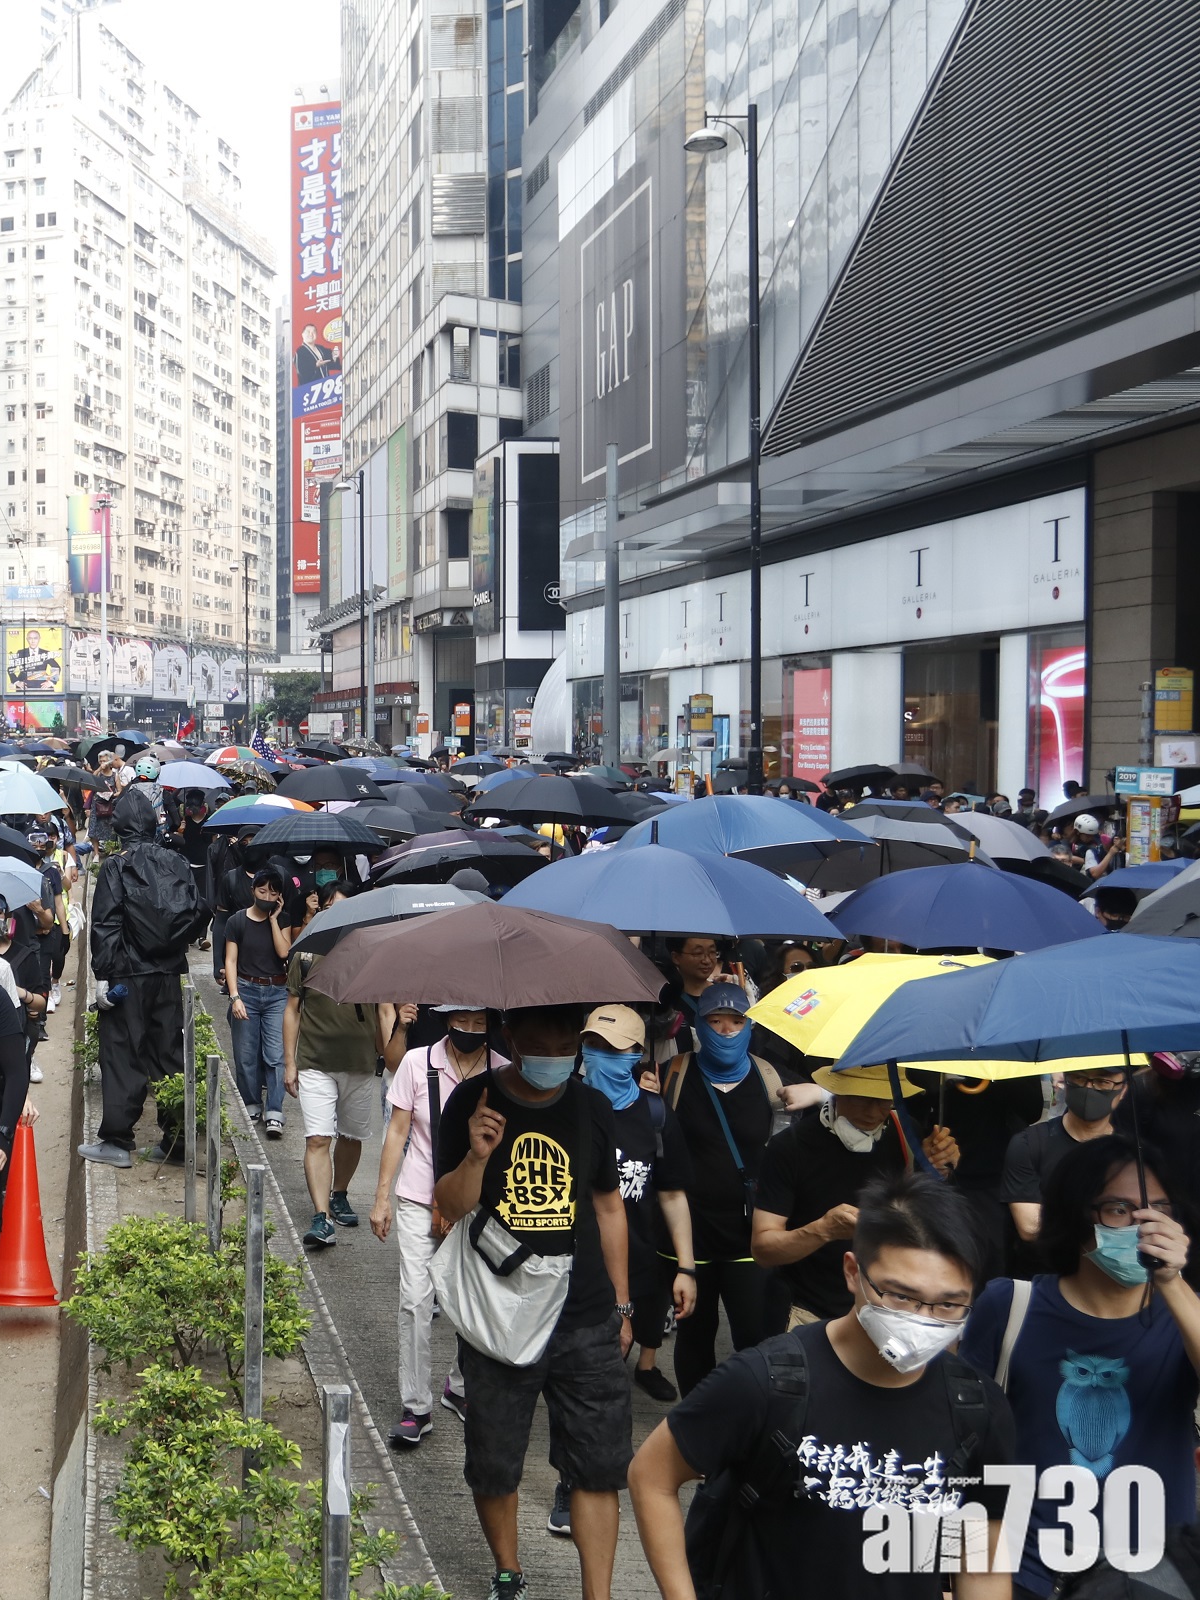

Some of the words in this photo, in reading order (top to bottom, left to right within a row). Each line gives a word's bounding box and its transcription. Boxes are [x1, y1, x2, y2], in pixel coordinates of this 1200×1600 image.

[300, 138, 327, 279] 才是真貨
[597, 279, 634, 399] GAP
[1043, 516, 1070, 563] T
[910, 547, 930, 587] T
[1033, 568, 1080, 584] GALLERIA
[473, 591, 492, 607] CHANEL
[799, 572, 815, 607] T
[901, 591, 937, 605] GALLERIA
[716, 591, 727, 622] T
[793, 611, 820, 622] GALLERIA
[514, 1138, 566, 1166] MINI
[513, 1161, 566, 1186] CHE
[514, 1186, 566, 1206] BSX
[512, 1218, 534, 1227] WILD
[535, 1218, 569, 1227] SPORTS
[797, 1435, 945, 1485] 原諒我這一生
